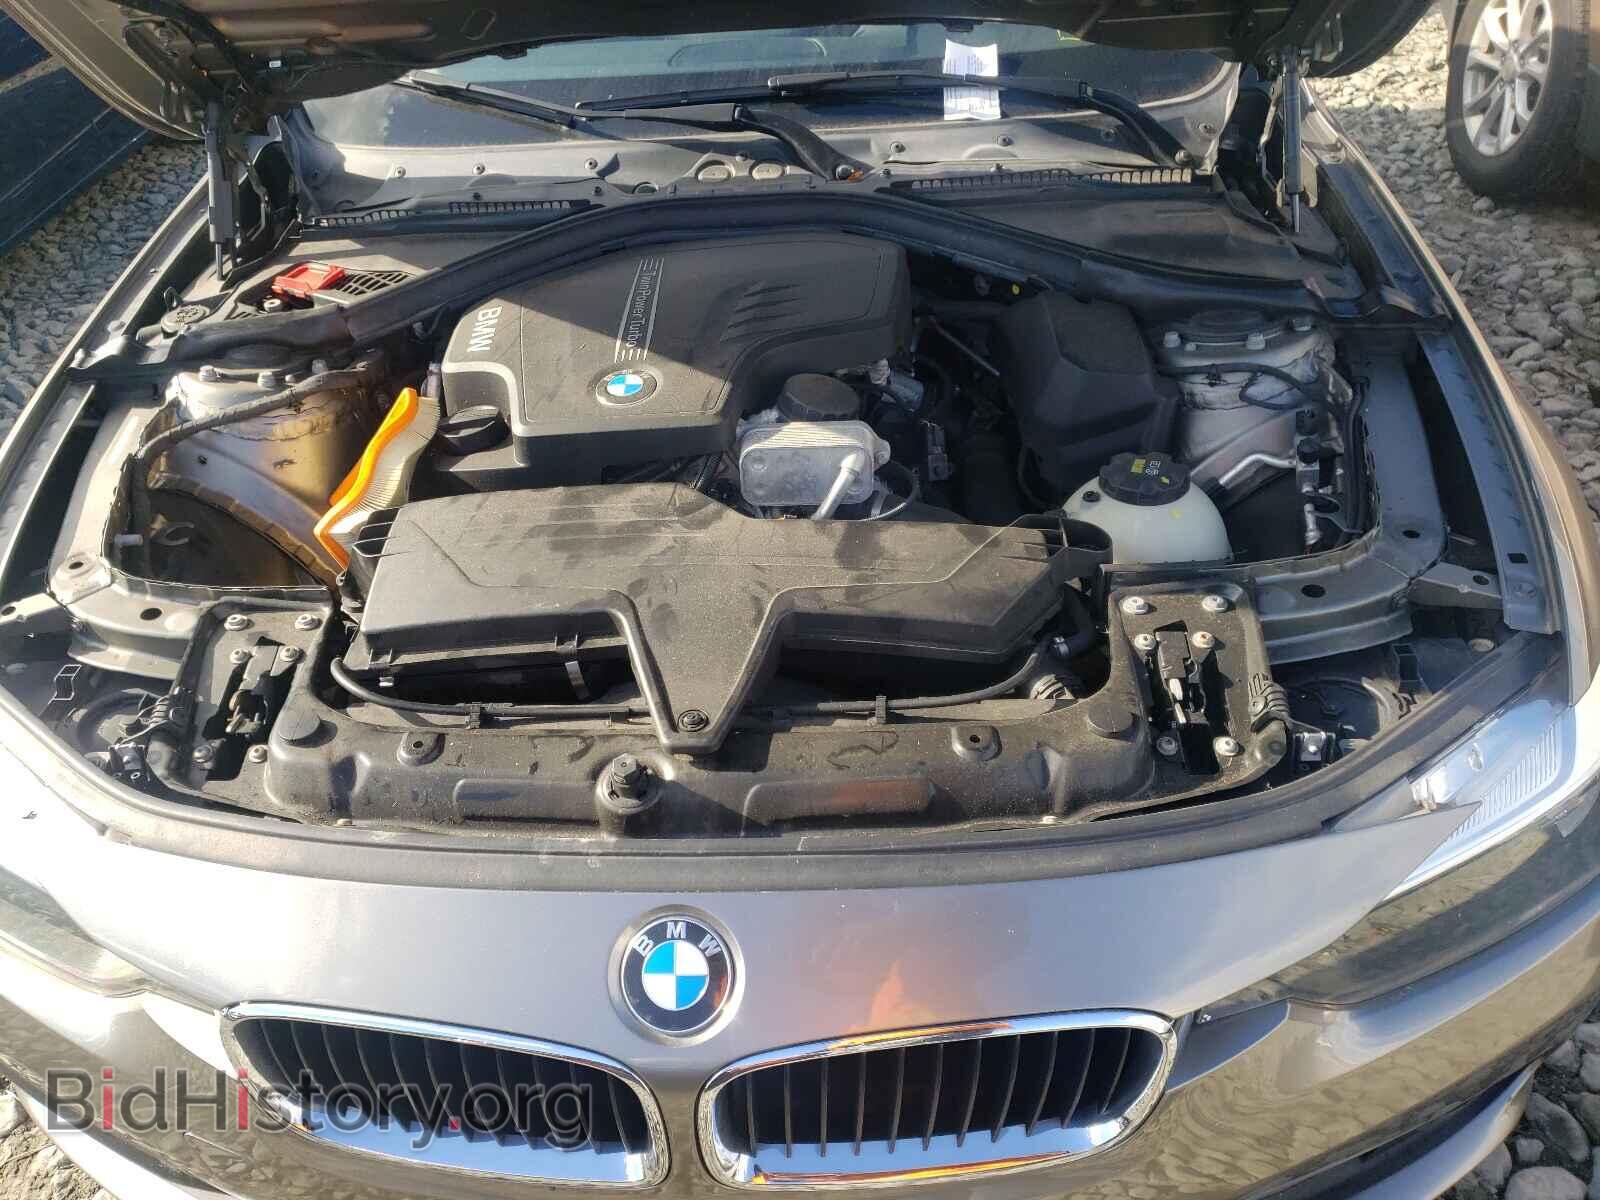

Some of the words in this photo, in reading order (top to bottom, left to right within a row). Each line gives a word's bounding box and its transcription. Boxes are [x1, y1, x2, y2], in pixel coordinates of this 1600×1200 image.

[633, 270, 657, 317] TwinPower
[467, 305, 503, 352] BMW
[626, 318, 646, 347] Turbo
[632, 921, 722, 958] BMW
